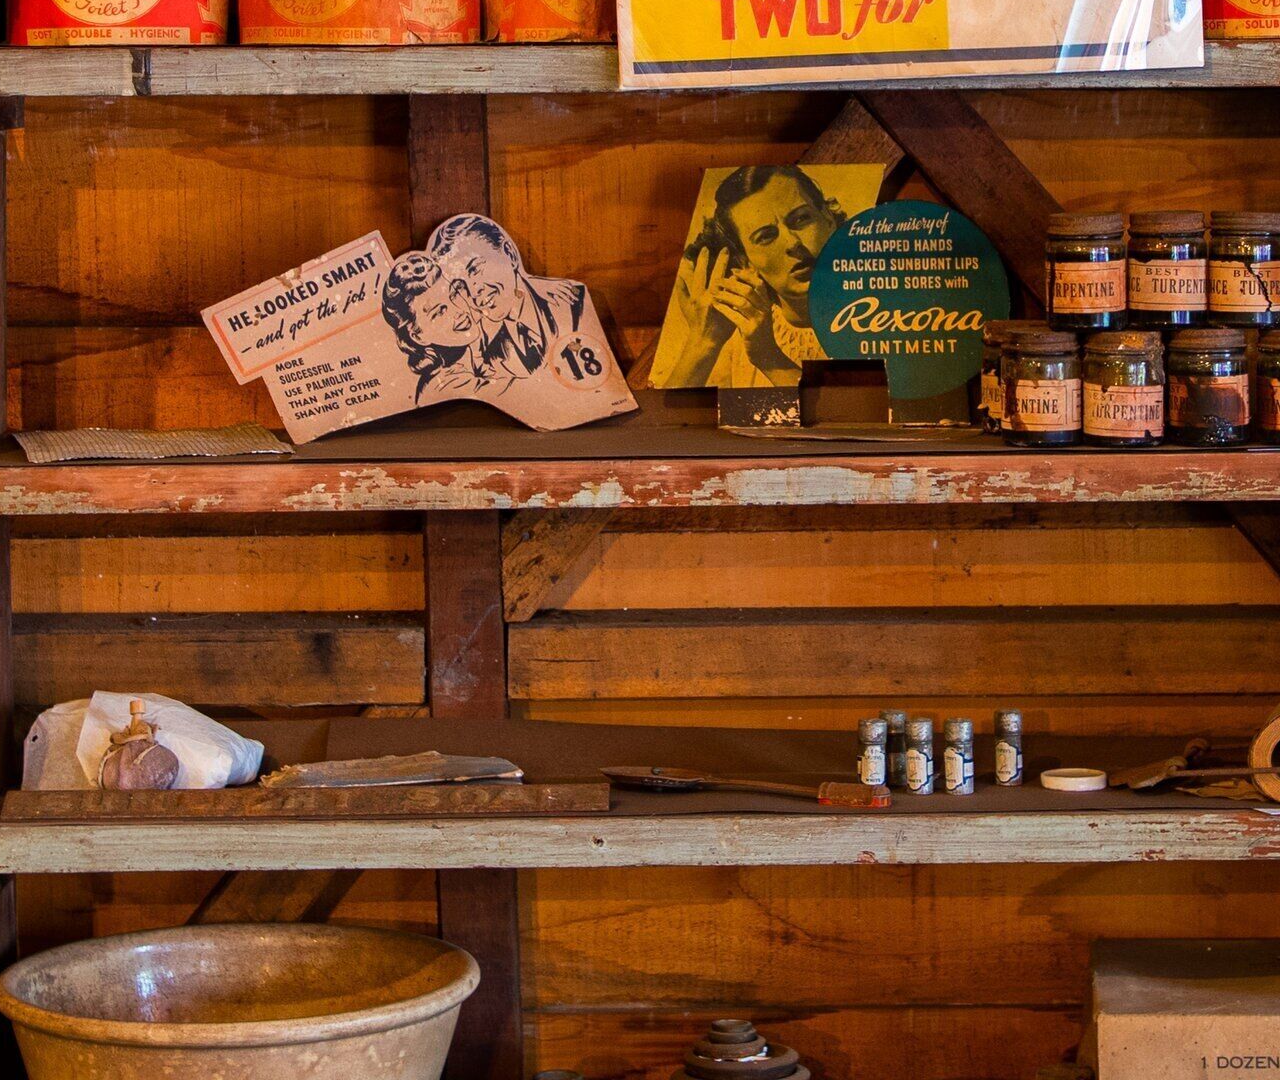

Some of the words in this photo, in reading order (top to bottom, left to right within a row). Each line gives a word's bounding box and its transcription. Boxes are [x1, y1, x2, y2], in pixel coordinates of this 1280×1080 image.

[64, 28, 113, 39] SOLUBLE
[130, 28, 181, 38] HYGIENIC
[848, 219, 872, 237] End
[875, 218, 894, 234] the
[896, 217, 936, 235] misery
[935, 212, 950, 235] of
[859, 239, 910, 253] CHAPPED
[914, 238, 953, 252] HANDS
[832, 259, 886, 272] CRACKED
[890, 257, 952, 271] SUNBURNT
[955, 257, 979, 270] LIPS
[1145, 267, 1180, 277] BEST
[842, 277, 863, 290] and
[869, 277, 899, 289] COLD
[904, 276, 941, 289] SORES
[944, 276, 969, 289] with
[1054, 282, 1115, 298] RPENTINE
[227, 311, 253, 332] HE
[255, 280, 320, 320] LOOKED
[322, 252, 376, 289] SMART
[255, 319, 284, 349] and
[289, 308, 315, 341] got
[316, 297, 338, 321] the
[342, 282, 366, 314] job
[830, 296, 986, 333] Rexona
[860, 339, 958, 354] OINTMENT
[275, 357, 305, 373] MORE
[279, 363, 334, 385] SUCCESSFUL
[340, 356, 362, 369] MEN
[285, 387, 302, 398] USE
[306, 371, 355, 392] PALMOLIVE
[289, 395, 318, 409] THAN
[323, 388, 345, 401] ANY
[349, 378, 381, 392] OTHER
[294, 403, 340, 420] SHAVING
[345, 391, 380, 407] CREAM
[1216, 1056, 1280, 1070] DOZEN
